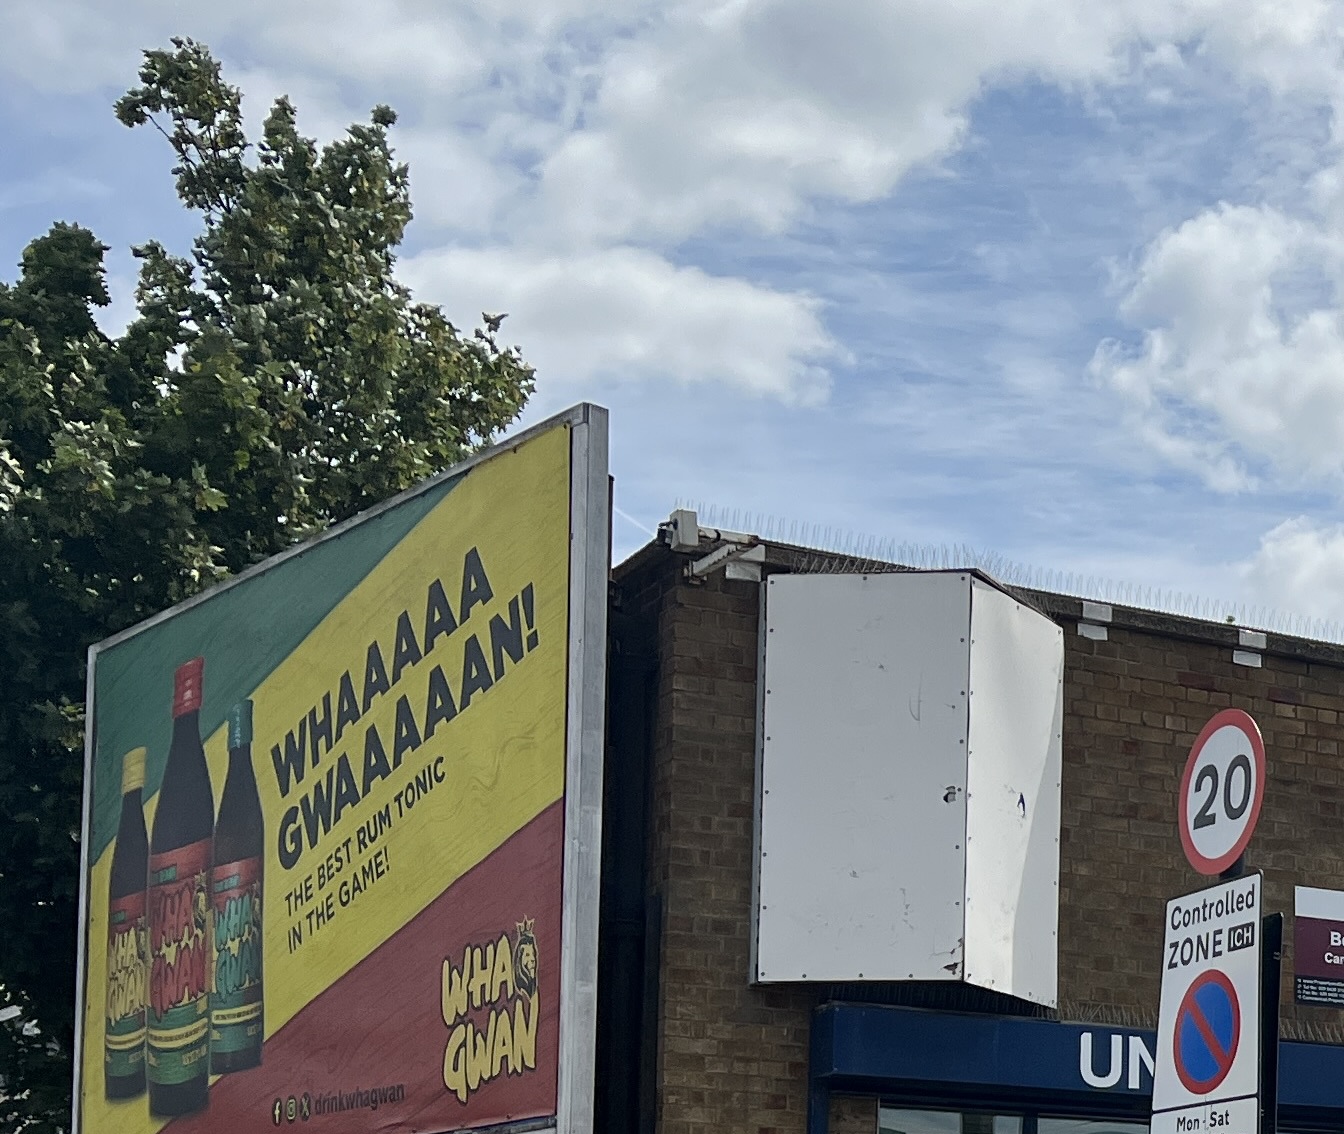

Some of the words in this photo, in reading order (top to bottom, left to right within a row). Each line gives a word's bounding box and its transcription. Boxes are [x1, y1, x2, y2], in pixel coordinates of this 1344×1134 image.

[270, 546, 494, 798] WHAAAAA
[278, 581, 540, 870] GWAAAAAN!
[285, 878, 313, 917] THE
[317, 837, 353, 891] BEST
[357, 802, 392, 849] RUM
[393, 755, 447, 819] TONIC
[1193, 754, 1252, 830] 20
[288, 920, 302, 954] IN
[306, 892, 335, 936] THE
[338, 846, 391, 908] GAME!
[1167, 929, 1223, 970] ZONE
[1229, 924, 1253, 949] ICH
[1171, 884, 1255, 931] Controlled
[441, 932, 514, 1026] WHA
[442, 991, 539, 1106] GWAN
[314, 1084, 405, 1115] drinkwhagwan
[1177, 1113, 1199, 1132] Mon
[1209, 1110, 1229, 1128] Sat
